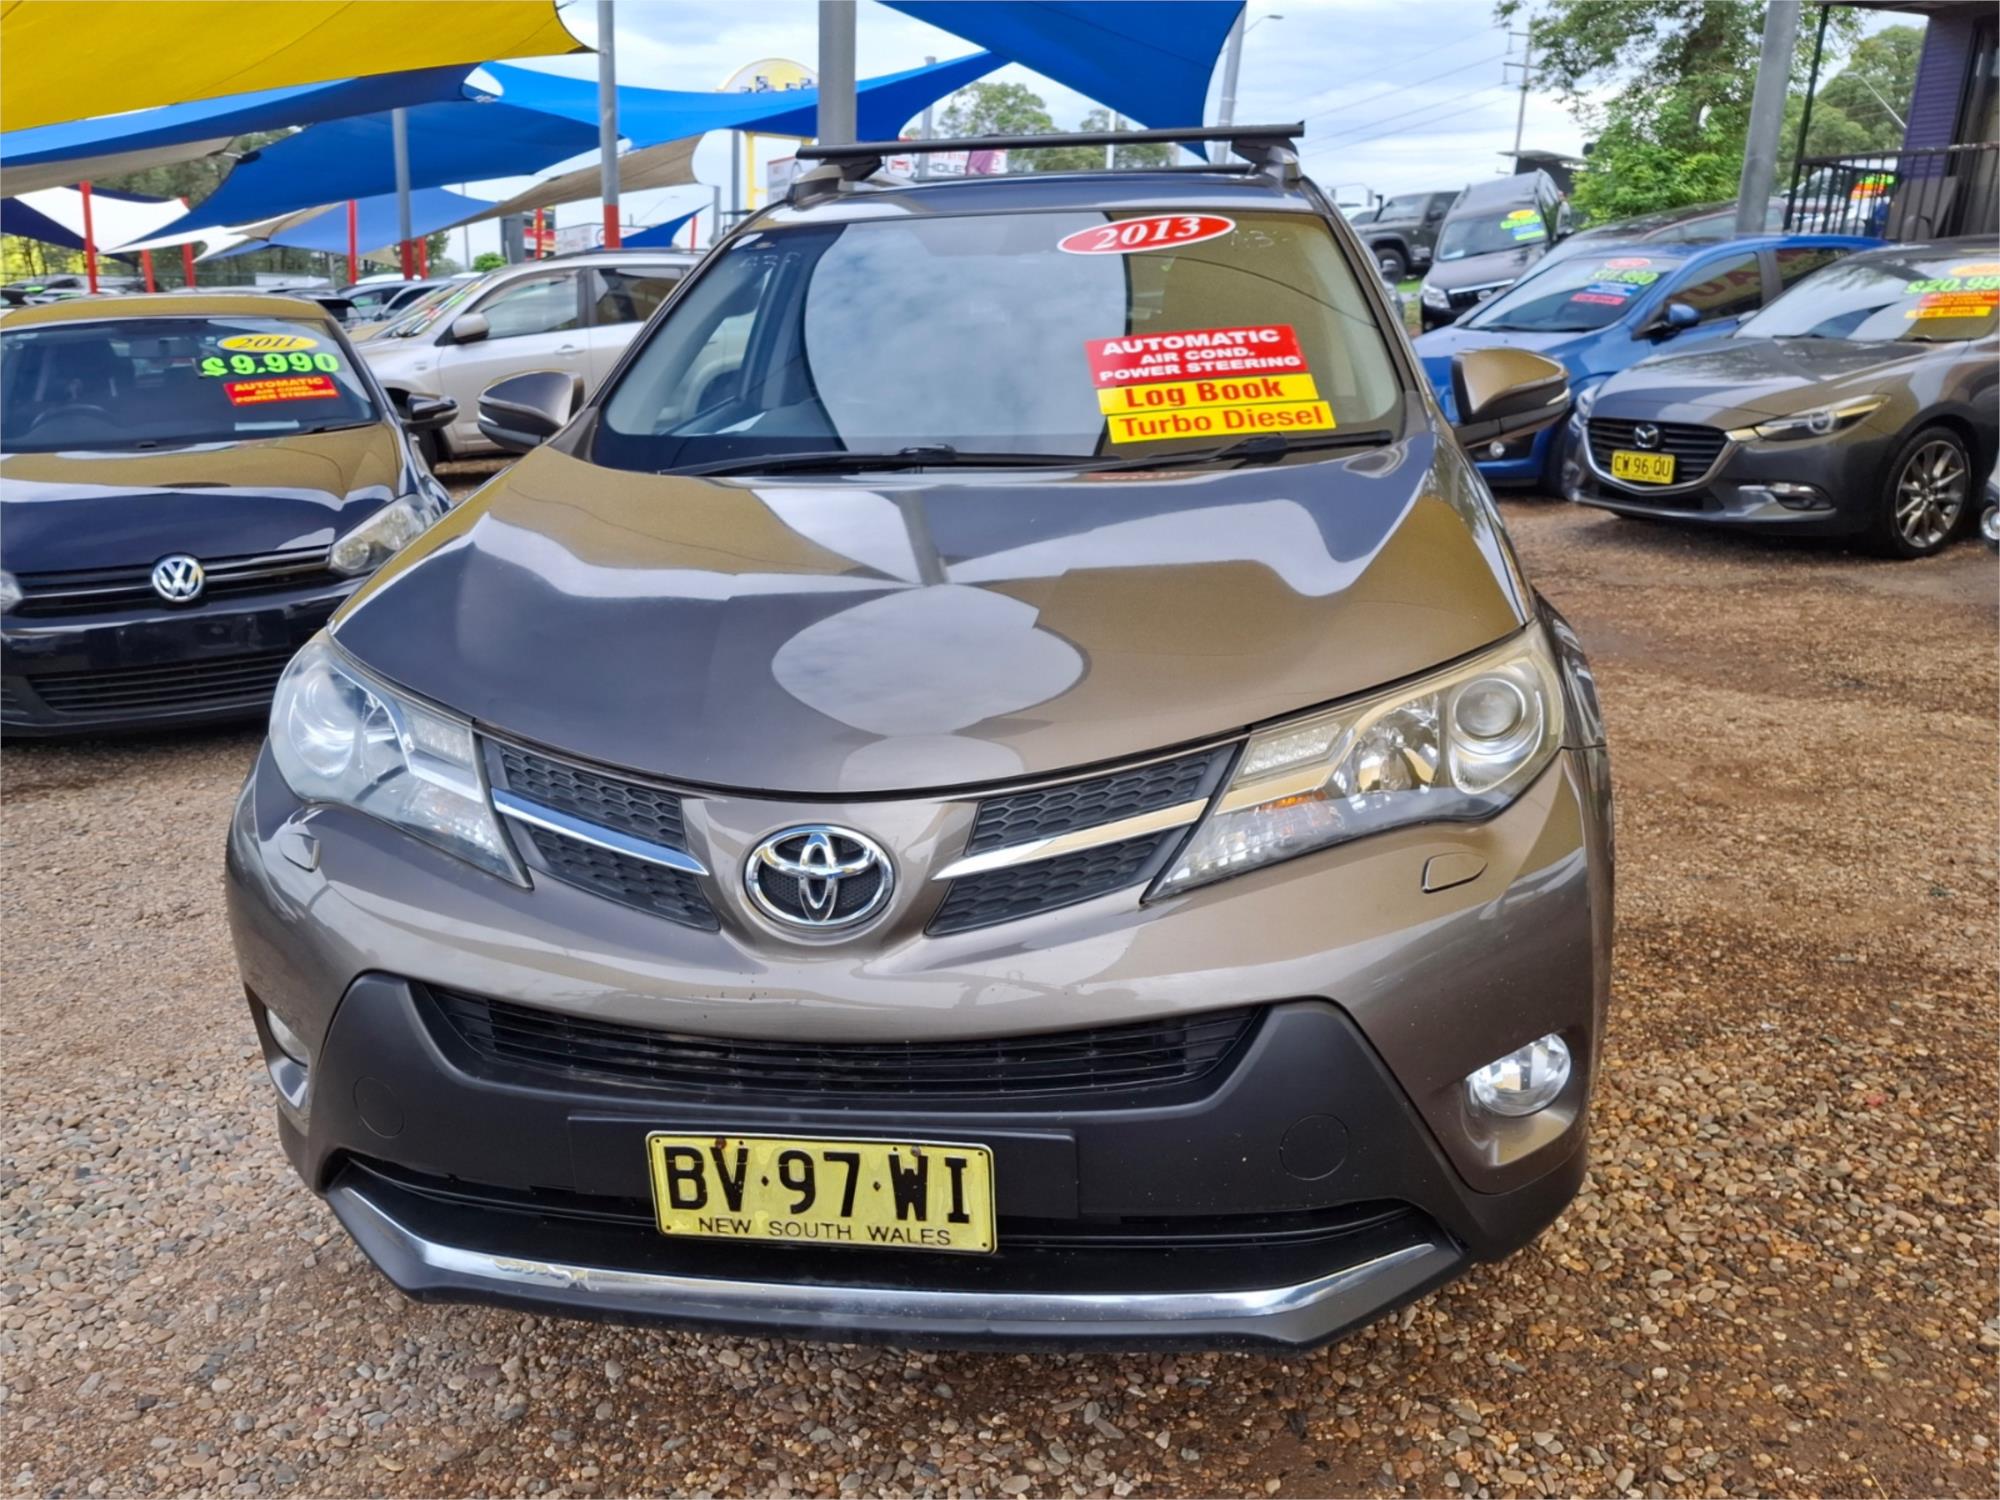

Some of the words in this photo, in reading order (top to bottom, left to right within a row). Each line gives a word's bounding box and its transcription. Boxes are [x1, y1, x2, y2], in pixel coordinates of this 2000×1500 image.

[1092, 217, 1202, 251] 2013
[232, 337, 297, 349] 2011
[1102, 328, 1281, 357] AUTOMATIC
[1140, 351, 1178, 366] AIR
[1184, 346, 1256, 361] COND.
[201, 352, 340, 377] $9.990
[1099, 363, 1182, 382] POWER
[1186, 355, 1302, 374] STEERING
[233, 377, 325, 393] AUTOMATIC
[1124, 386, 1187, 409] Log
[1196, 377, 1285, 404] Book
[1119, 414, 1212, 438] Turbo
[1223, 406, 1324, 430] Diesel
[1633, 457, 1649, 475] 96
[698, 1216, 752, 1235] NEW
[768, 1219, 853, 1241] SOUTH
[867, 1225, 952, 1247] WALES
